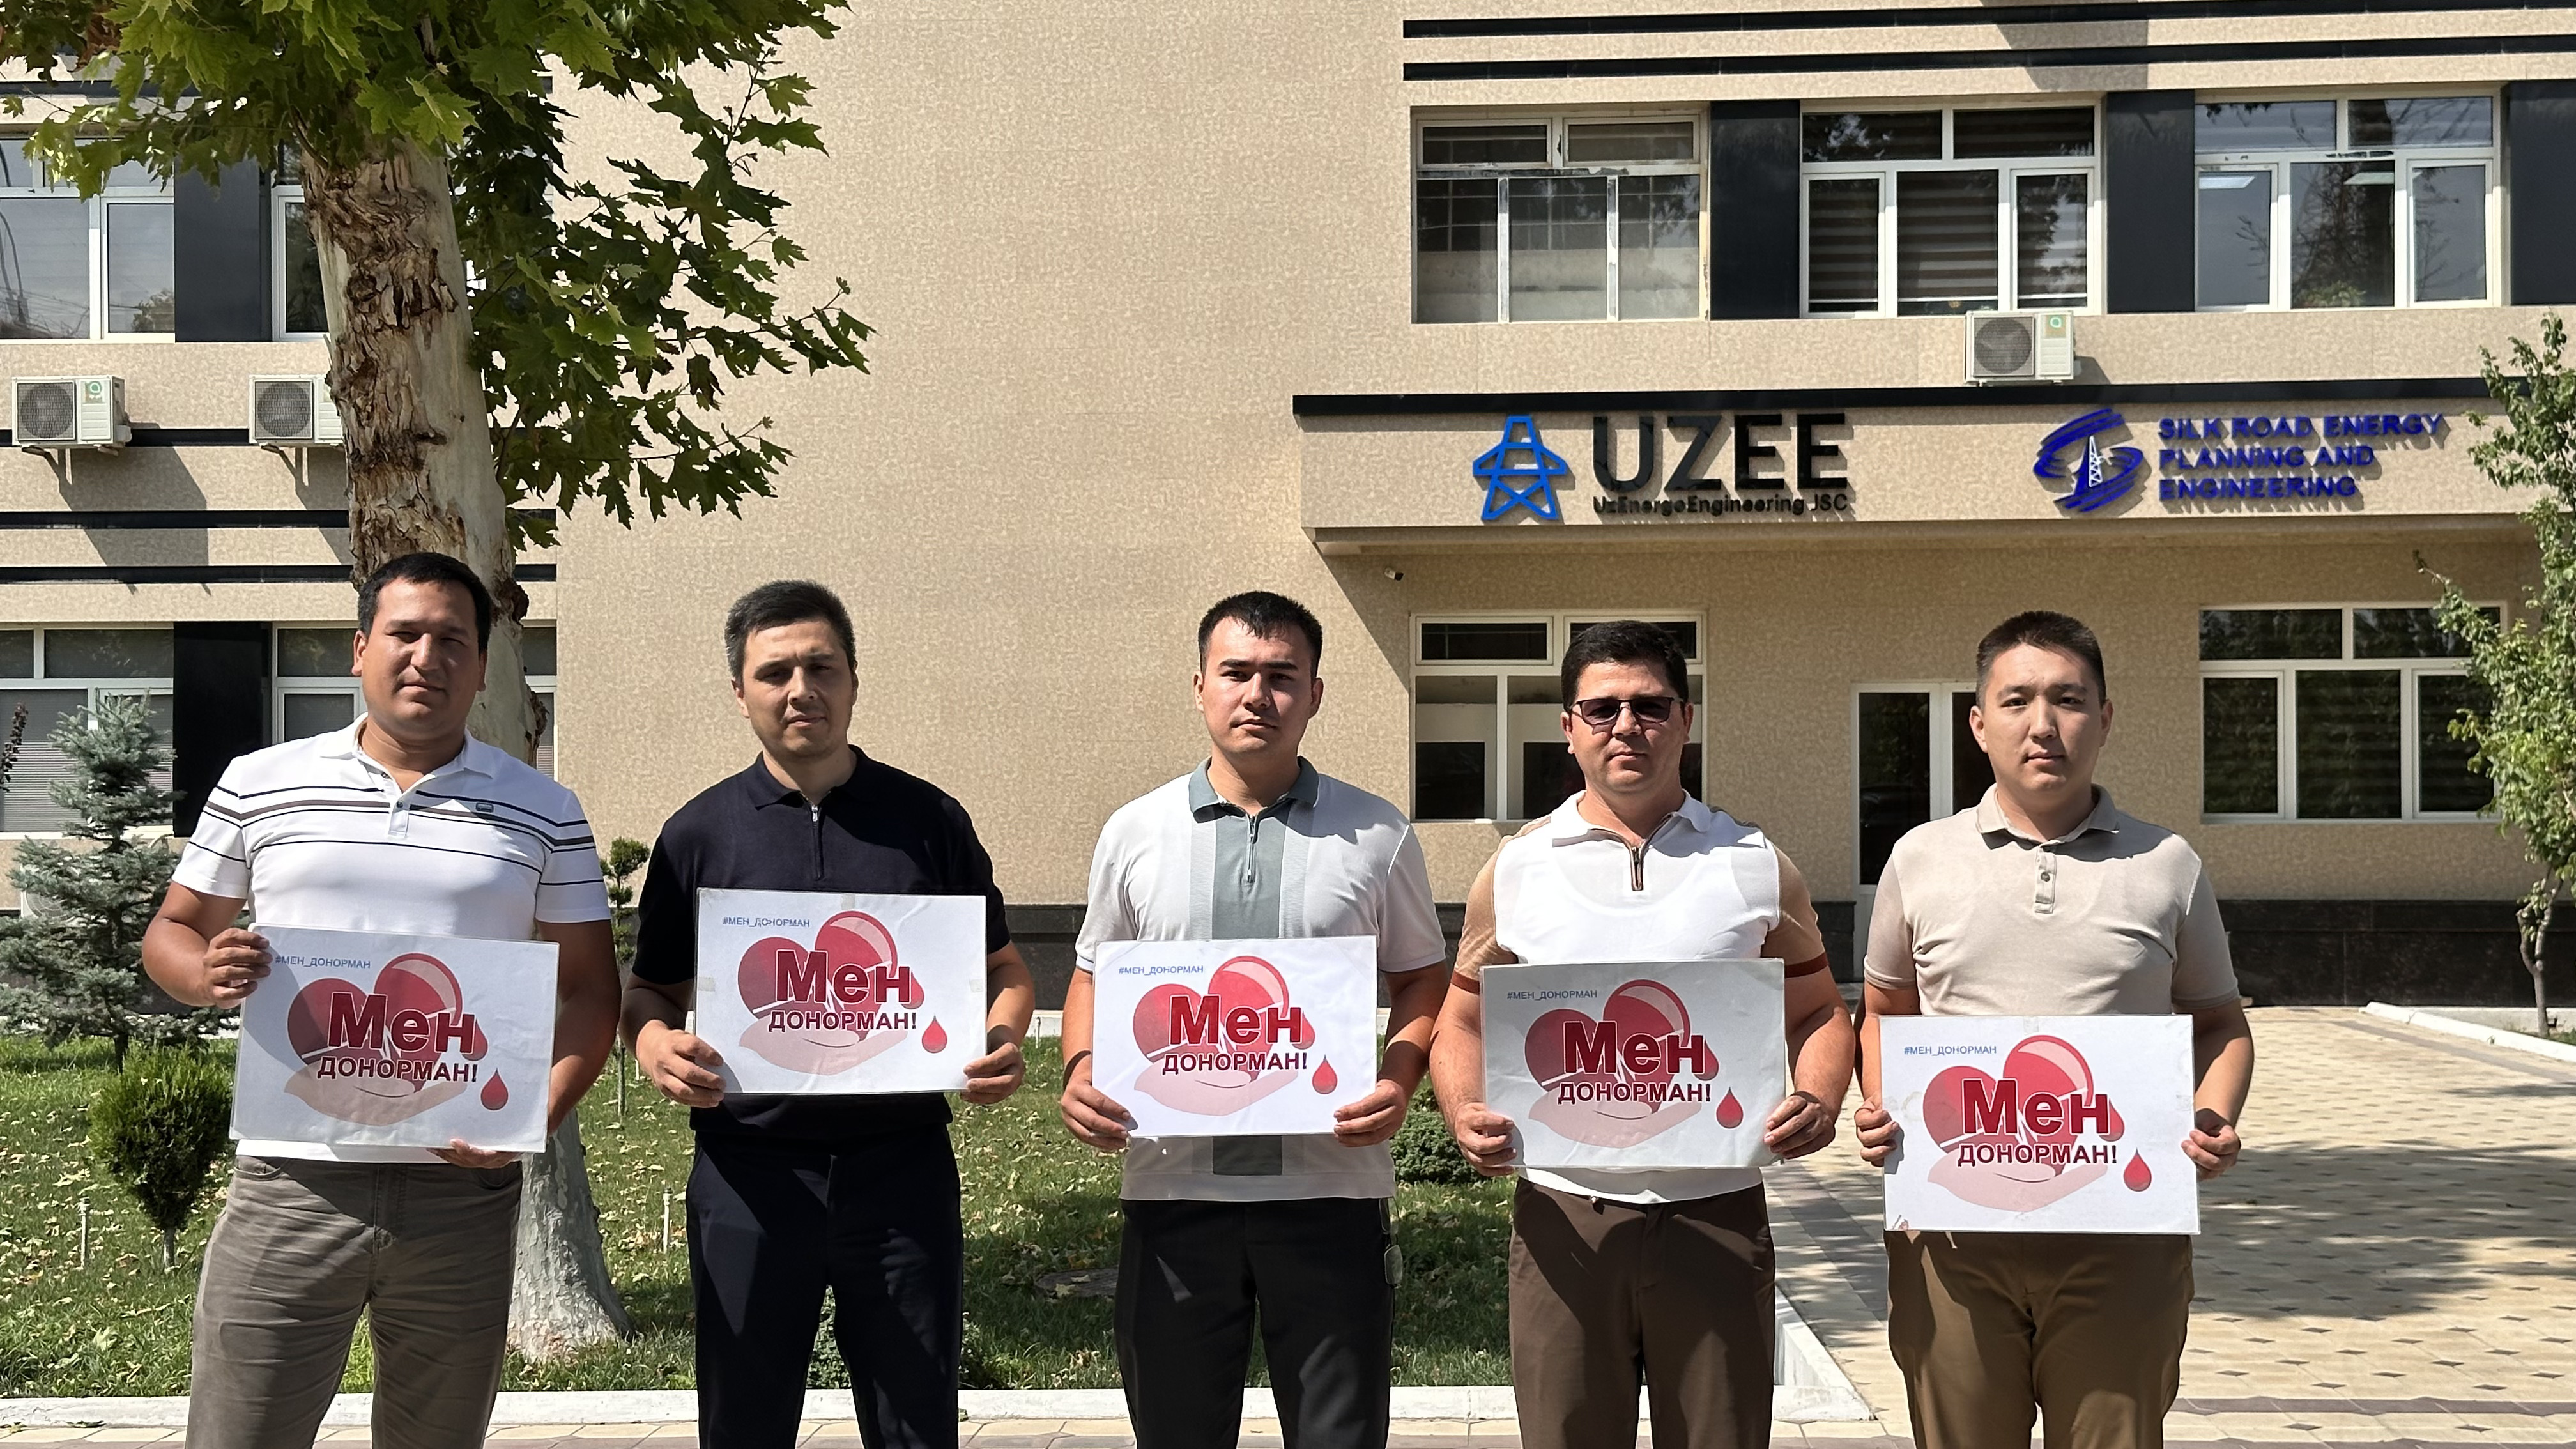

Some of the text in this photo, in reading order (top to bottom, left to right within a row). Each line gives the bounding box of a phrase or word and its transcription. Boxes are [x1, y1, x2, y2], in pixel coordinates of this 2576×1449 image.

[2158, 413, 2443, 440] SILK ROAD ENERGY
[1593, 413, 1848, 491] UZEE
[2158, 446, 2375, 470] PLANNING AND
[2159, 477, 2356, 501] ENGINEERING
[1593, 494, 1848, 515] UzEnergoEngineering JSC
[723, 917, 811, 928] #МЕН_ДОНОРМАН
[275, 956, 371, 969] #МЕН_ДОНОРМАН
[1119, 965, 1204, 976] #МЕН_ДОНОРМАН
[776, 951, 911, 1003] Мен
[1507, 990, 1598, 1000] #МЕН_ДОНОРМАН
[328, 992, 477, 1054] Мен
[769, 1011, 917, 1033] ДОНОРМАН!
[1170, 995, 1302, 1045] Мен
[1563, 1022, 1705, 1074] Мен
[1904, 1046, 1997, 1056] #МЕН_ДОНОРМАН
[318, 1056, 478, 1083] ДОНОРМАН!
[1162, 1052, 1307, 1075] ДОНОРМАН!
[1558, 1083, 1711, 1105] ДОНОРМАН!
[1962, 1080, 2110, 1135] Мен
[1958, 1145, 2117, 1168] ДОНОРМАН!
